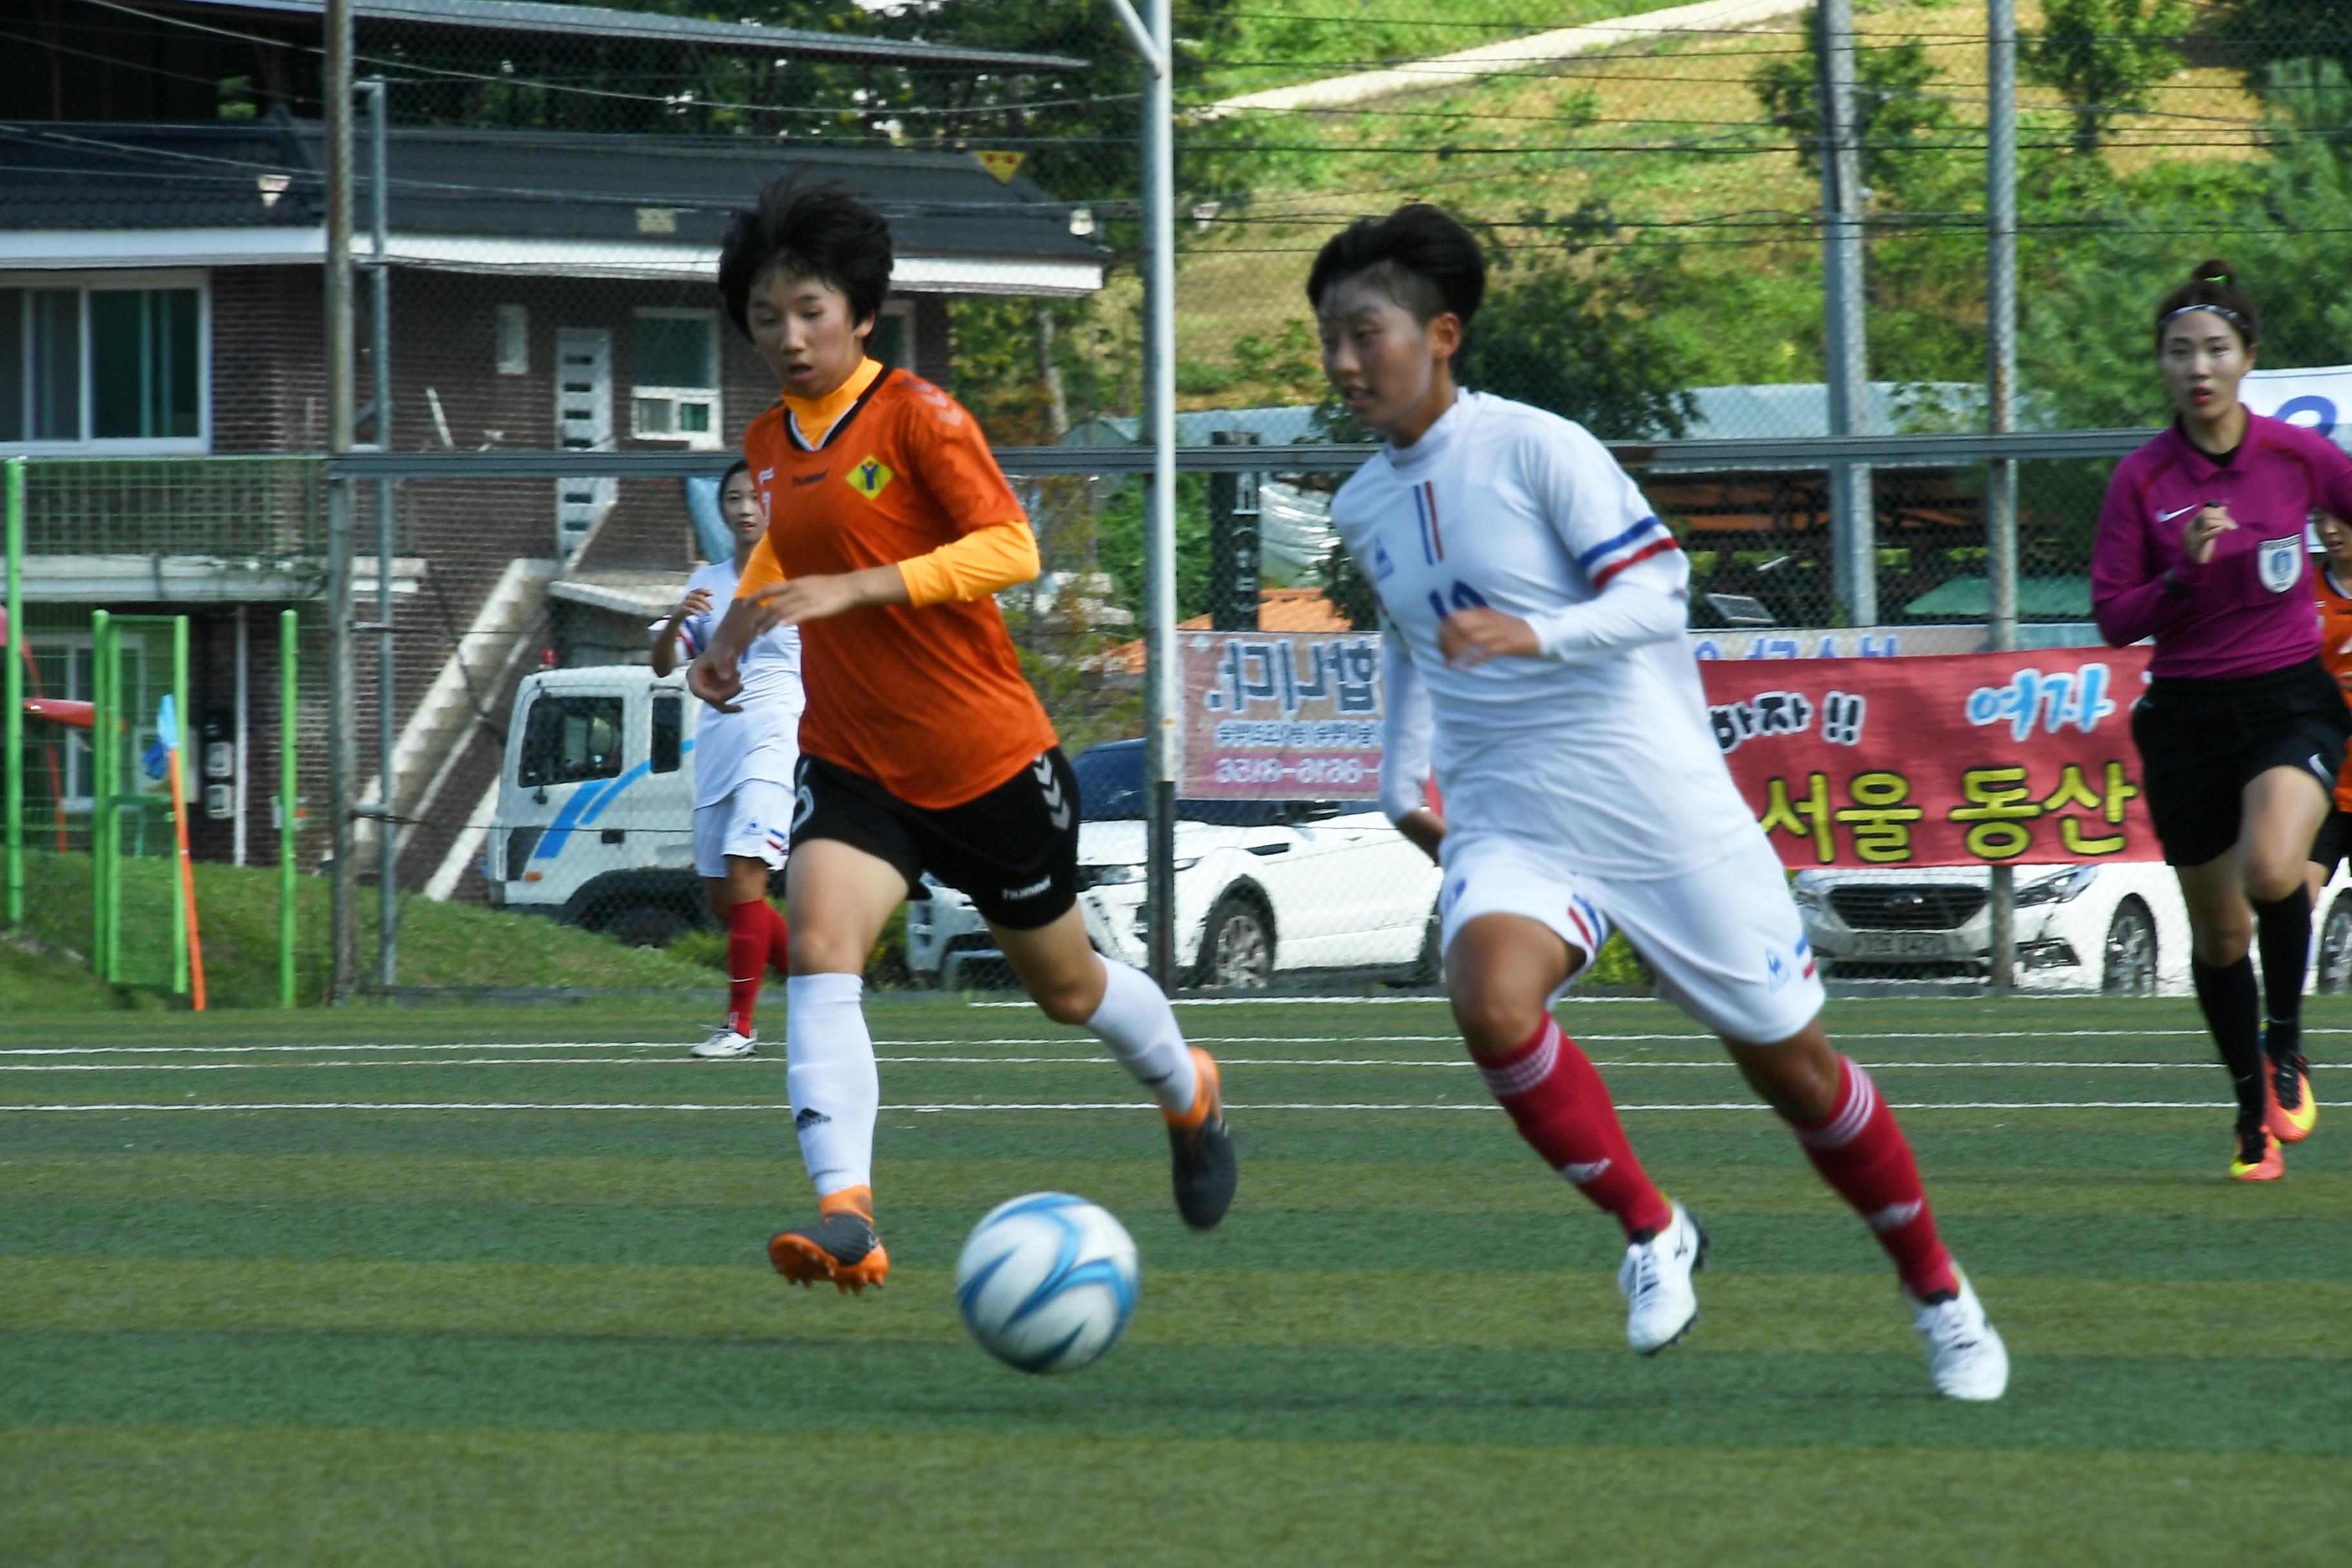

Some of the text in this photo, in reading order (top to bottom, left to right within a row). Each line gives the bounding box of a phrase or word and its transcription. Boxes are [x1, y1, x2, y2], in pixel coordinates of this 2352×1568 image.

[1966, 665, 2112, 740] 여자
[1759, 760, 2139, 863] 서울 동산
